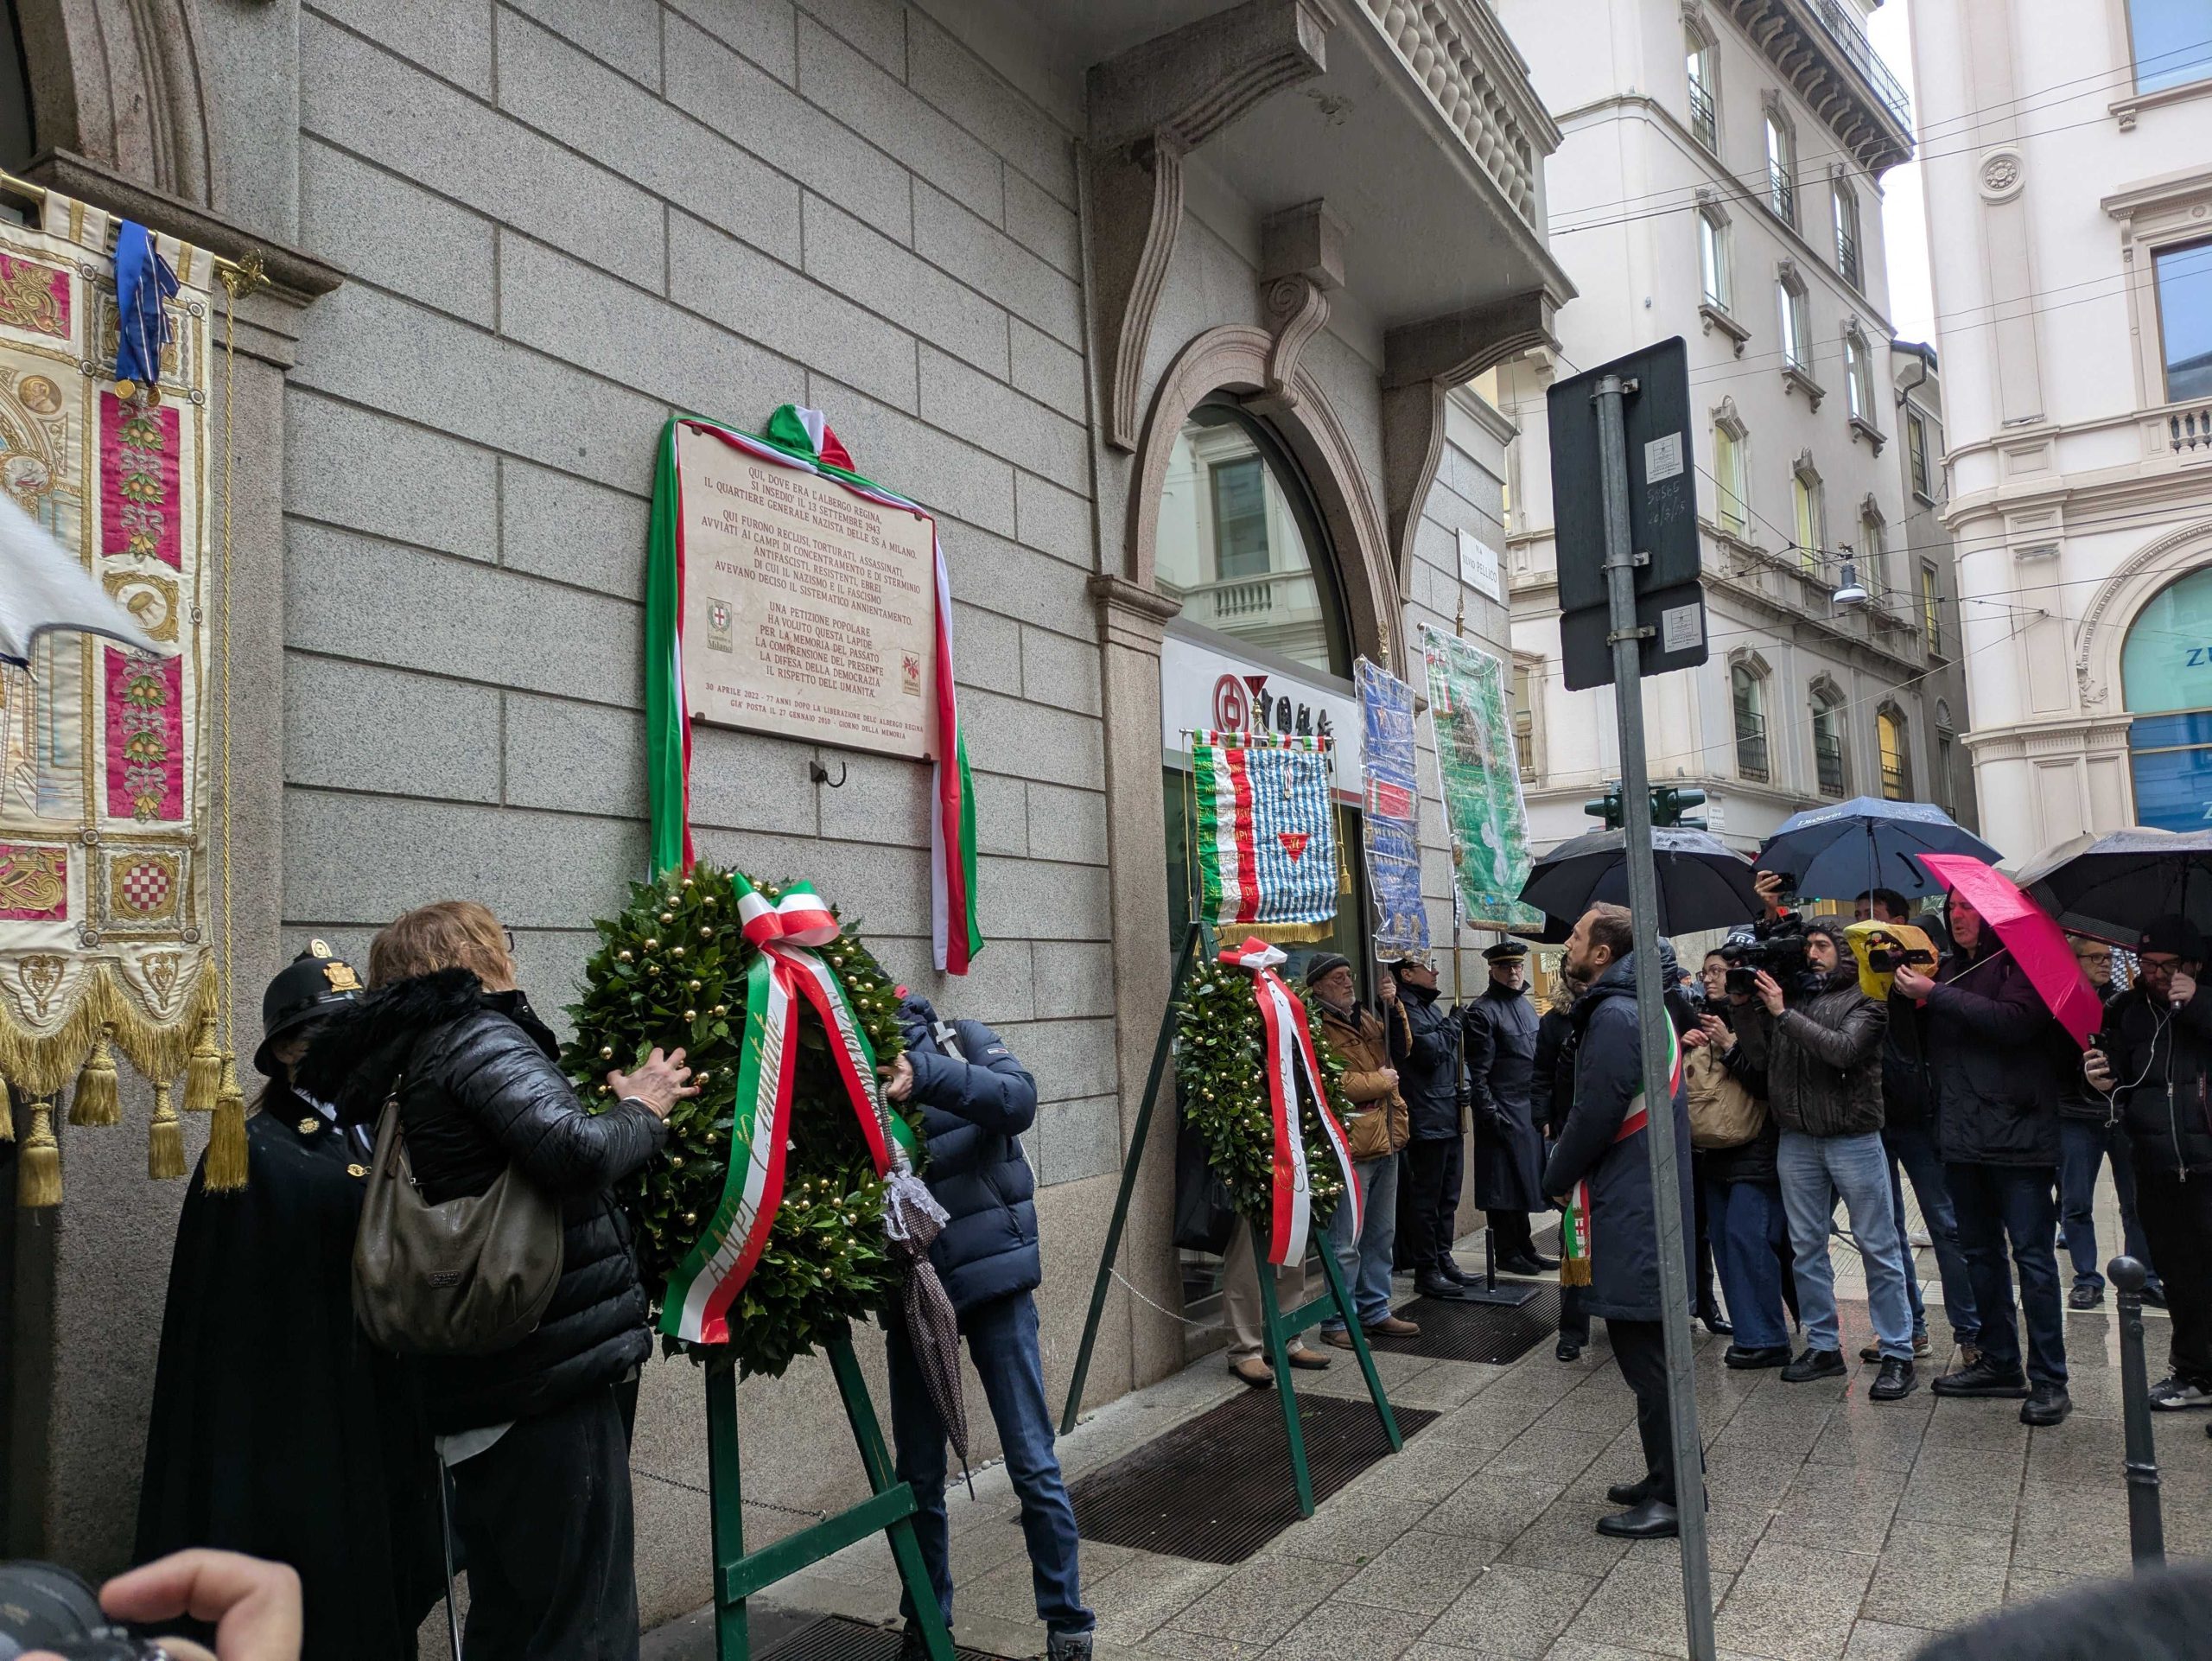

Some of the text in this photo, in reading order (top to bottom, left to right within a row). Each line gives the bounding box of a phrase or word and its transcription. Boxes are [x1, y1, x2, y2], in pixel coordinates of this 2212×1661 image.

[768, 474, 790, 490] DOVE
[792, 482, 810, 498] ERA
[704, 476, 713, 488] IL
[715, 480, 765, 506] QUARTIERE
[766, 499, 810, 522] GENERALE
[812, 514, 844, 534] NAZISTA
[847, 526, 869, 543] DELLE
[870, 535, 880, 546] SS
[880, 539, 887, 549] A
[722, 509, 738, 523] QUI
[741, 514, 774, 534] FURONO
[751, 480, 759, 492] SI
[798, 497, 805, 508] IL
[808, 501, 817, 512] 13
[819, 505, 863, 529] SETTEMBRE
[865, 522, 880, 535] 1943
[701, 515, 920, 594] AVVIATI AI CAMPI DI CONCENTRAMENTO E DI STERMINIO
[1477, 562, 1497, 583] PELLICO
[714, 560, 756, 580] AVEVANO
[758, 572, 787, 589] DECISO
[789, 581, 798, 593] IL
[799, 585, 849, 608] SISTEMATICO
[753, 557, 881, 605] DI CUI IL NAZISMO E IL FASCISMO
[861, 579, 881, 594] EBREI
[767, 613, 872, 650] HA VOLUTO QUESTA LAPIDE
[769, 601, 871, 637] UNA PETIZIONE POPOLARE
[755, 636, 884, 677] LA COMPRENSIONE DEL PRESENTE
[760, 624, 880, 663] PER LA MEMORIA DEL PASSATO
[2186, 647, 2212, 667] Z
[760, 650, 880, 688] LA DIFESA DELLA DEMOCRAZIA
[766, 665, 775, 676] IL
[777, 667, 817, 685] RISPETTO
[705, 682, 714, 690] 30
[716, 684, 741, 697] APRILE
[744, 690, 759, 700] 2022
[775, 697, 791, 706] ANNI
[794, 700, 810, 710] DOPO
[812, 703, 821, 712] LA
[823, 706, 861, 720] LIBERAZIONE
[879, 718, 903, 729] ALBERGO
[904, 722, 923, 733] REGINA
[746, 702, 766, 713] POSTA
[769, 706, 776, 715] IL
[779, 708, 786, 716] 27
[788, 710, 816, 722] GENNAIO
[817, 716, 831, 725] 2010
[838, 720, 860, 730] GIORNO
[861, 724, 879, 735] DELLA
[880, 729, 906, 740] MEMORIA
